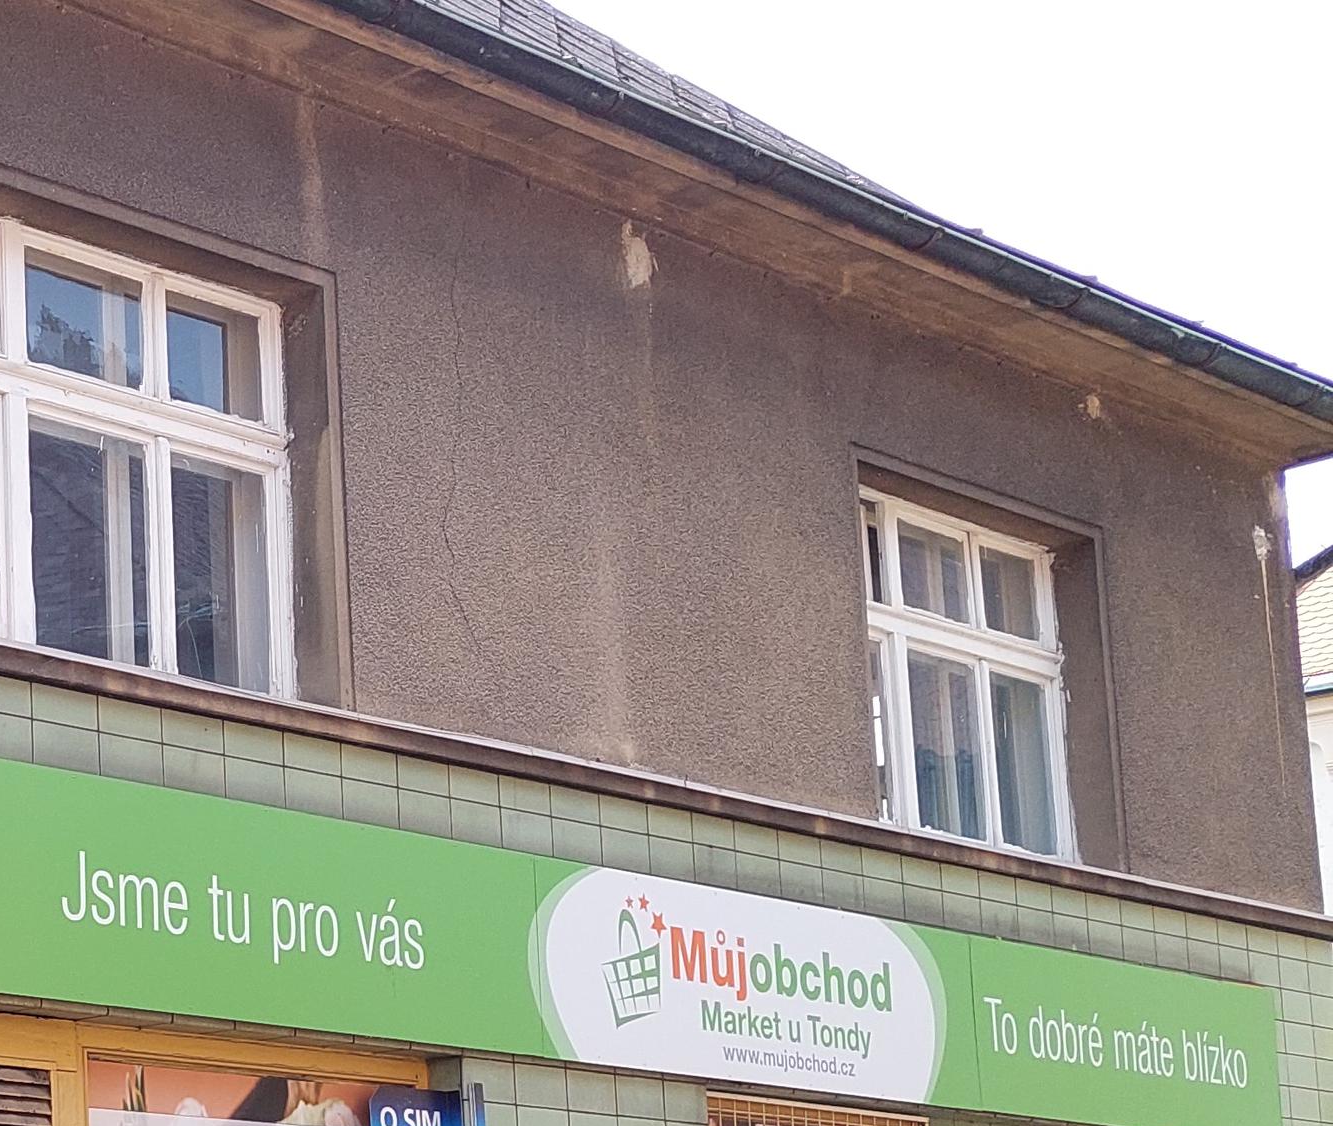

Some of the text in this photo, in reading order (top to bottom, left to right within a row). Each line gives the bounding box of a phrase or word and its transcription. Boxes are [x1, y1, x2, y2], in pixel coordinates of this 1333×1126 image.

[61, 850, 425, 971] Jsme tu pro vás
[669, 925, 893, 1012] Můjobchod
[700, 999, 871, 1059] Market u Tondy
[722, 1046, 856, 1077] www.mujobchod.cz
[983, 996, 1248, 1089] To dobré máte blízko
